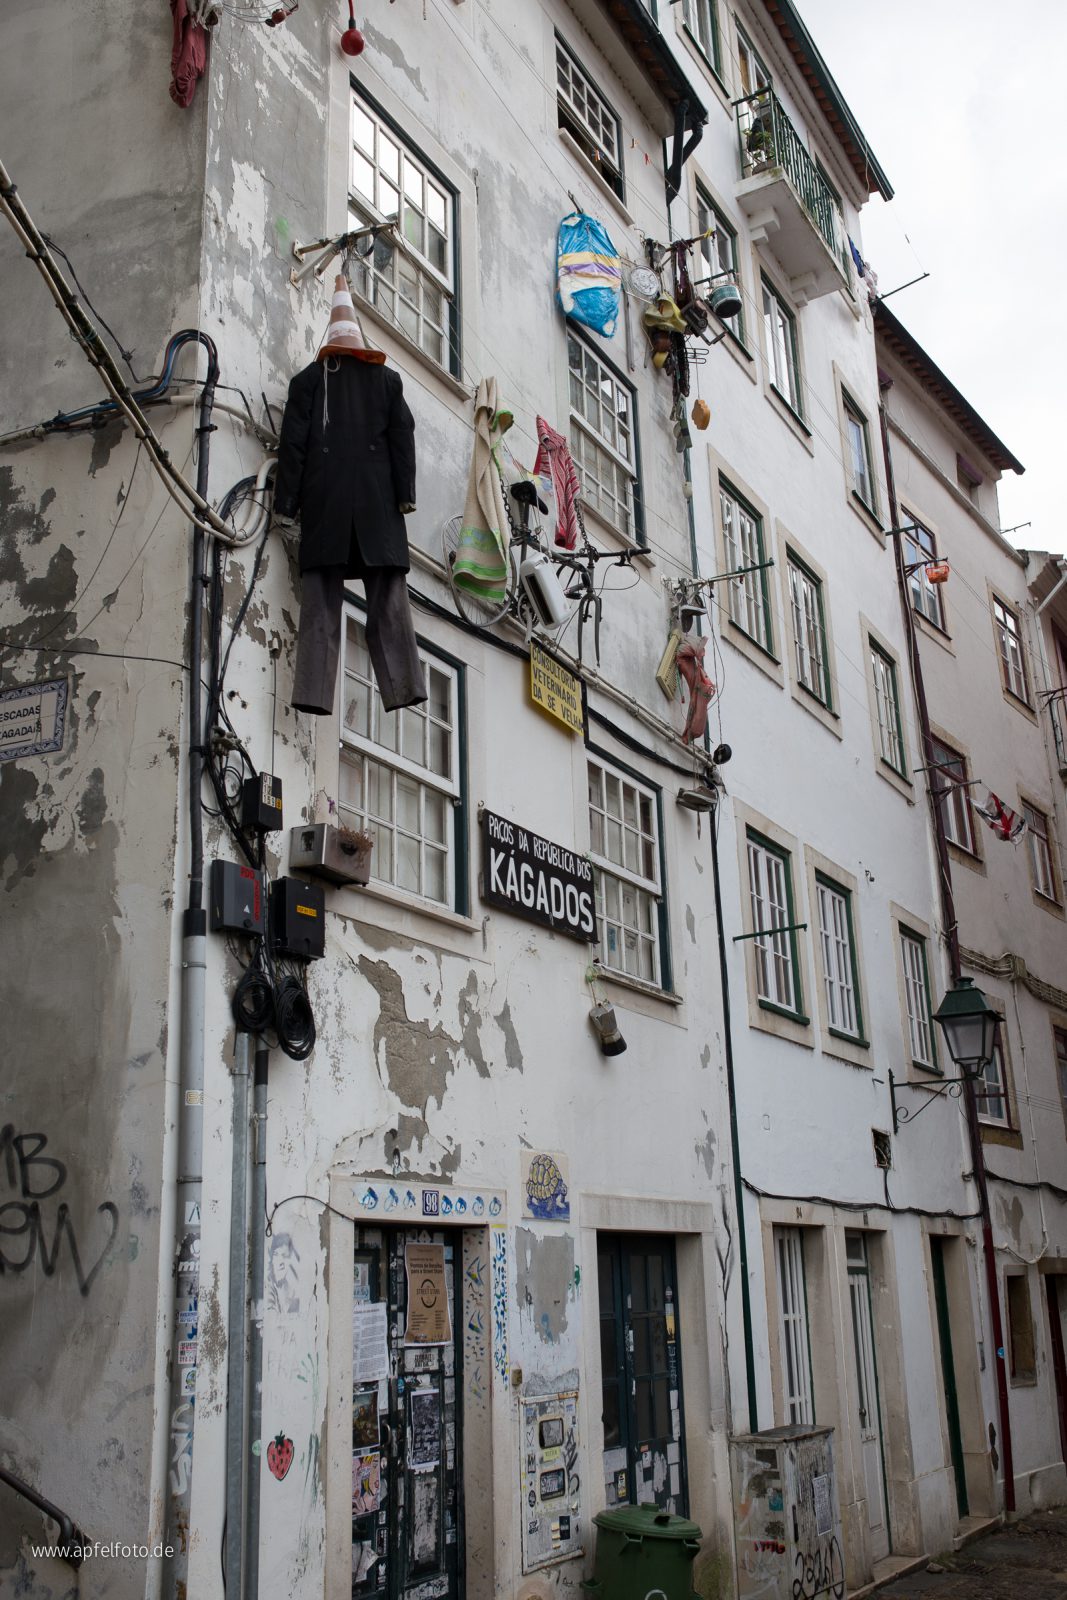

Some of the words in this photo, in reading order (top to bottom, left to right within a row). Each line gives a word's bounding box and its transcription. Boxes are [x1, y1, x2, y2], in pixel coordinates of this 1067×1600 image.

[533, 664, 577, 711] VETERINARIO
[533, 684, 543, 703] DA
[547, 694, 556, 712] SE
[488, 814, 514, 845] PAÇOS
[518, 830, 530, 853] DA
[576, 858, 591, 881] DOS
[490, 847, 594, 933] KÁGADOS
[426, 1193, 437, 1212] 98
